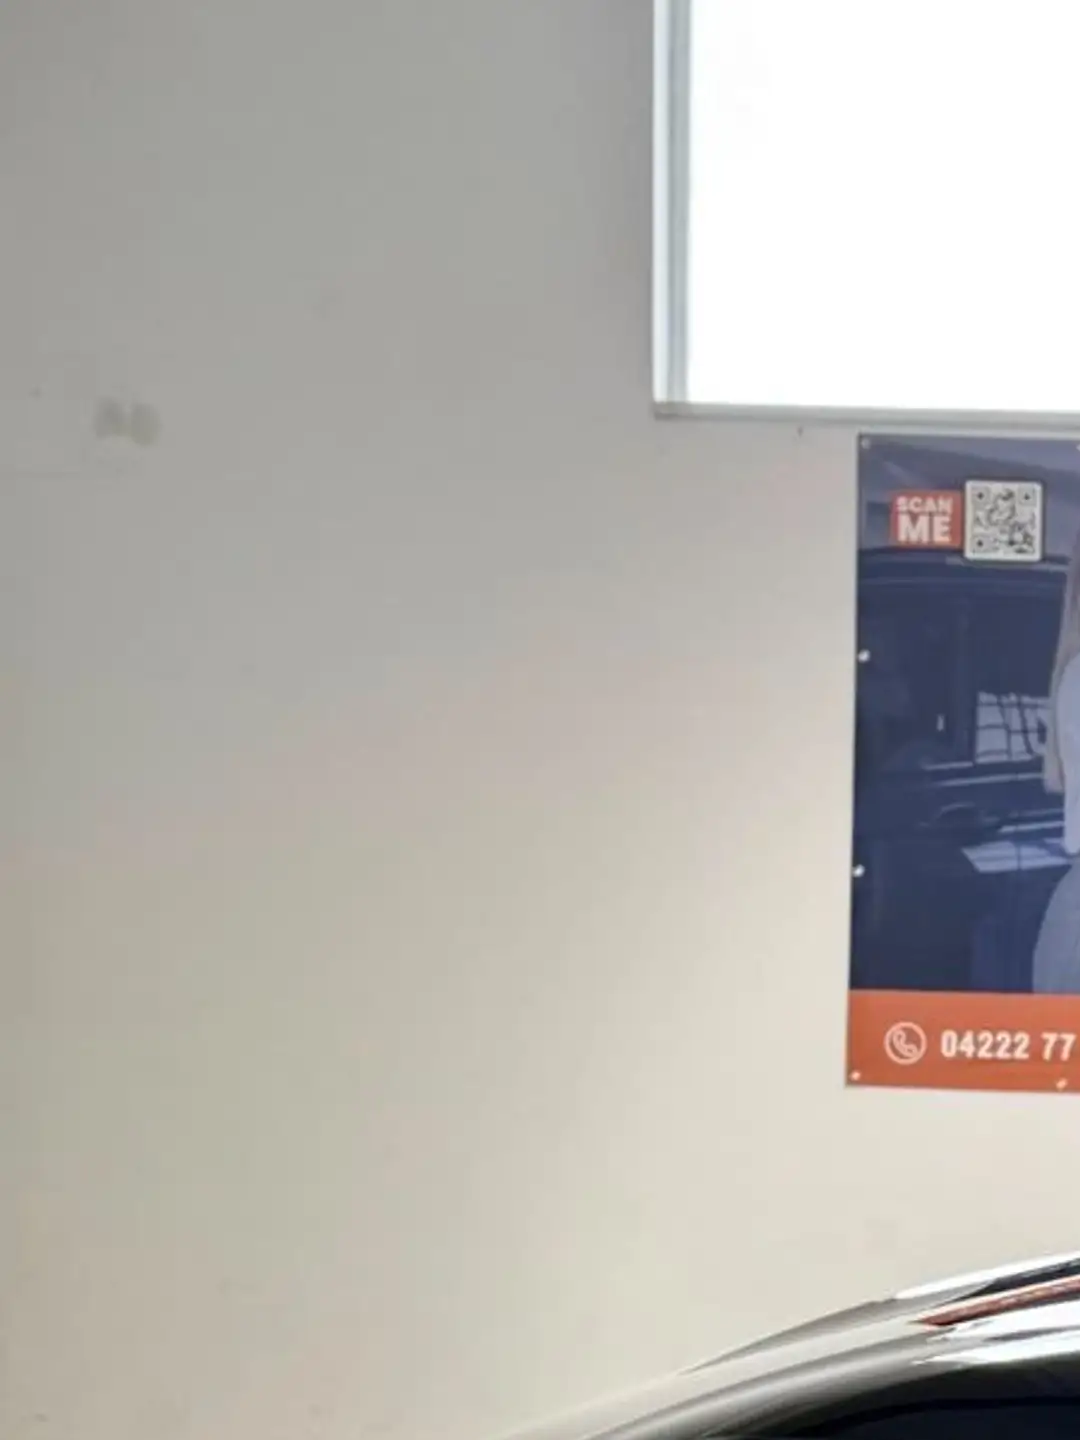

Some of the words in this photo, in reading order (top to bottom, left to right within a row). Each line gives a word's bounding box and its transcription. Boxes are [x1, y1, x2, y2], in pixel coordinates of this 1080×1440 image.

[896, 496, 953, 514] SCAN
[897, 513, 952, 543] ME
[940, 1030, 1030, 1060] 04222
[1041, 1032, 1076, 1061] 77
